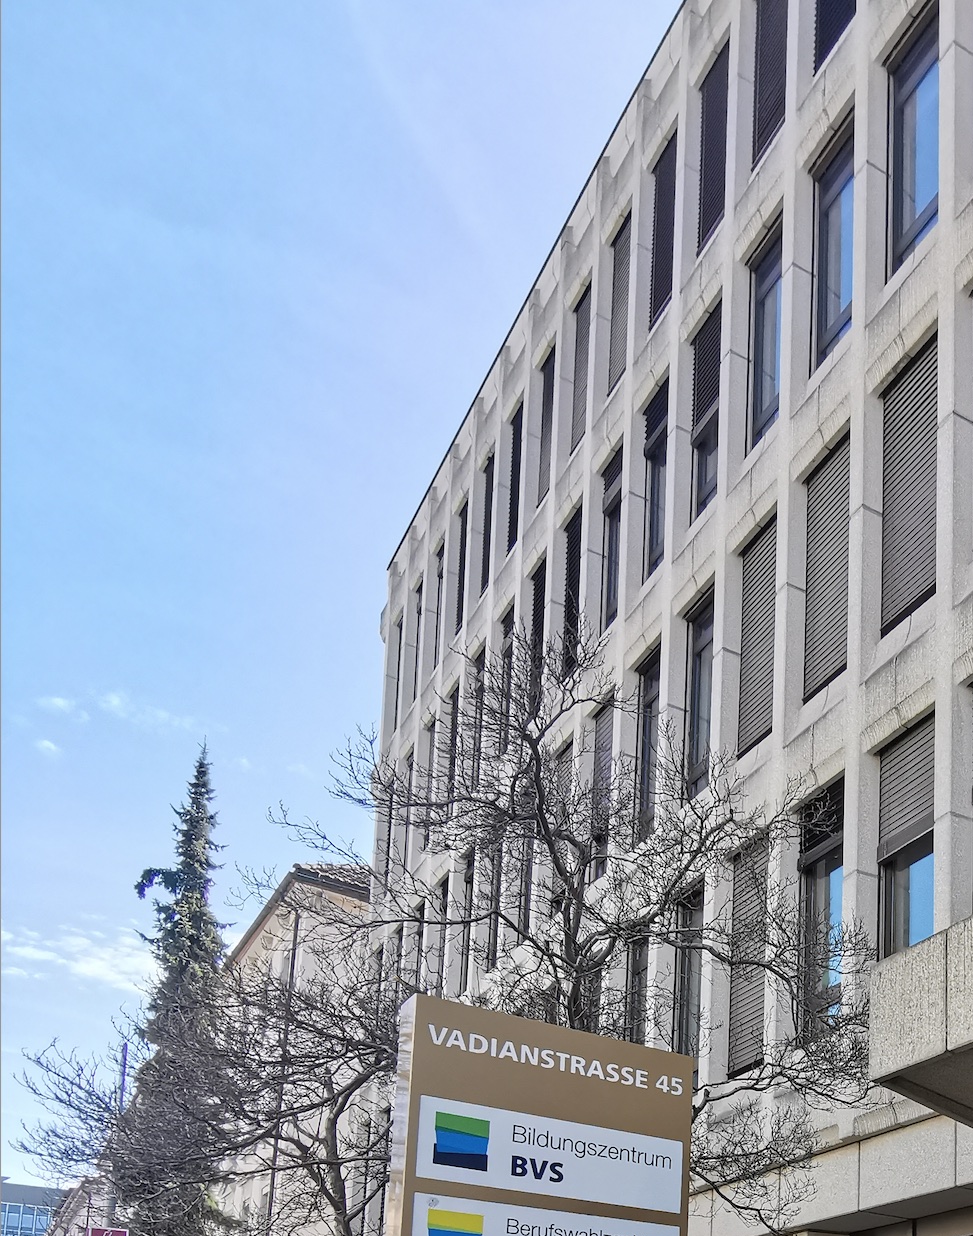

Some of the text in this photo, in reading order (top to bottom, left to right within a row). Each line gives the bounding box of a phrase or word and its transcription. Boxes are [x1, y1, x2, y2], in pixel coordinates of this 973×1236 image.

[428, 1024, 684, 1096] VADIANSTRASSE 45
[510, 1155, 565, 1184] BVS
[511, 1124, 673, 1170] Bildungszentrum
